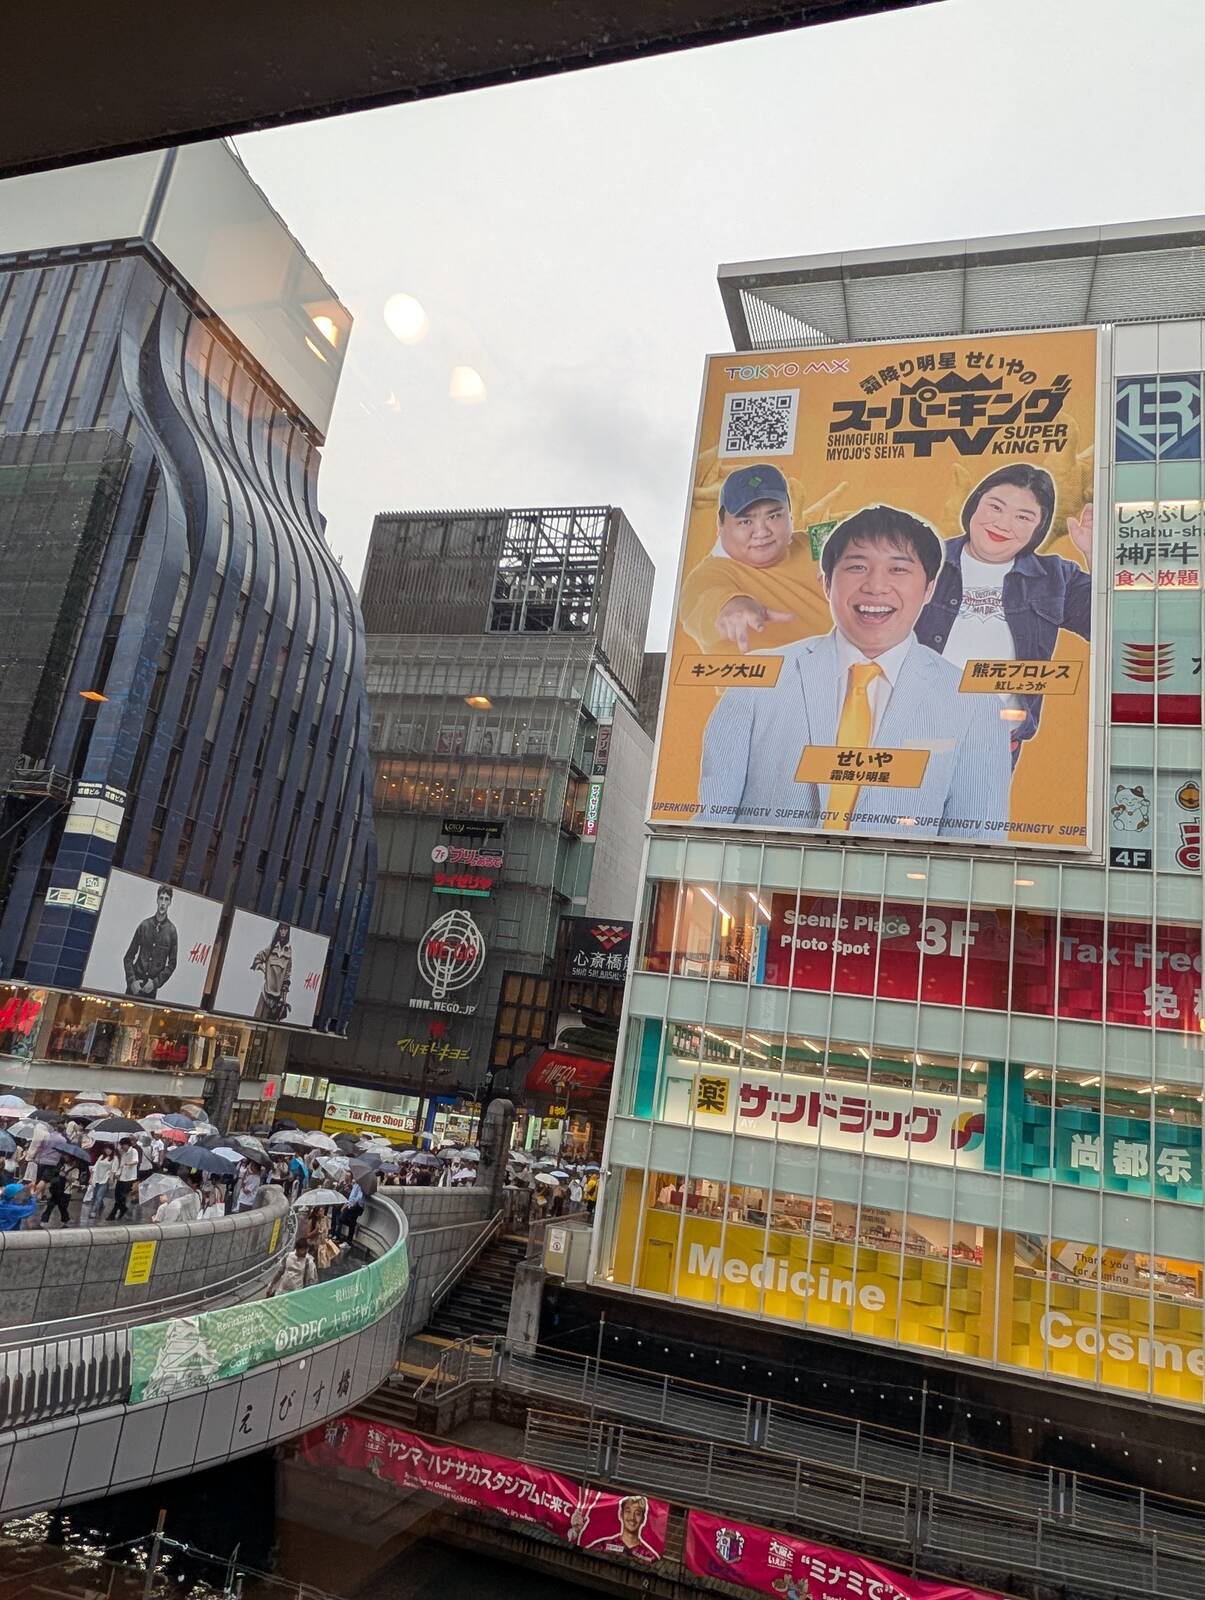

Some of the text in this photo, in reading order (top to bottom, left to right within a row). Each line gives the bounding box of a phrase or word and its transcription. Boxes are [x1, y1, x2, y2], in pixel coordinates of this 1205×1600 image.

[724, 358, 850, 380] TOKYO MX
[858, 351, 1038, 395] 霜降り明星 せいやの
[829, 374, 1073, 433] スーパーキング
[827, 432, 889, 447] SHIMOFURI
[893, 426, 1003, 458] TV
[1003, 423, 1068, 440] SUPER
[826, 445, 905, 461] MYOJO'S SEIYA
[991, 438, 1068, 455] KING TV
[1118, 503, 1205, 524] しゃぶし
[1115, 541, 1200, 565] 神戸牛
[1115, 569, 1199, 587] 食べ放題
[691, 663, 766, 679] キング大山
[971, 662, 1071, 679] 熊元プロレス
[994, 680, 1048, 692] 紅しょうが
[836, 750, 894, 768] せいや
[829, 769, 891, 783] 霜降り明星
[710, 804, 772, 818] SUPERKINGTV
[775, 808, 839, 821] SUPERKINGTV
[914, 815, 982, 830] SUPERKINGTV
[984, 820, 1054, 834] SUPERKINGTV
[1116, 851, 1146, 867] 4F
[783, 909, 912, 936] Scenic Place
[780, 934, 871, 956] Photo Spot
[917, 917, 980, 957] 3F
[1059, 936, 1121, 966] Tax
[408, 998, 476, 1016] WWW.WEGO.JP
[697, 1077, 728, 1113] 薬
[348, 1109, 362, 1120] Tax
[363, 1112, 382, 1124] Free
[382, 1114, 404, 1128] Shop
[739, 1083, 942, 1143] サンドラッグ
[1071, 1133, 1192, 1183] 尚都乐
[1110, 1260, 1129, 1272] you
[687, 1243, 887, 1312] Medicine
[1039, 1311, 1205, 1377] Cosme
[239, 1369, 351, 1434] えびす橋
[387, 1438, 574, 1518] ヤンマーハナサカスタジアムに来て
[769, 1540, 794, 1560] 大阪と
